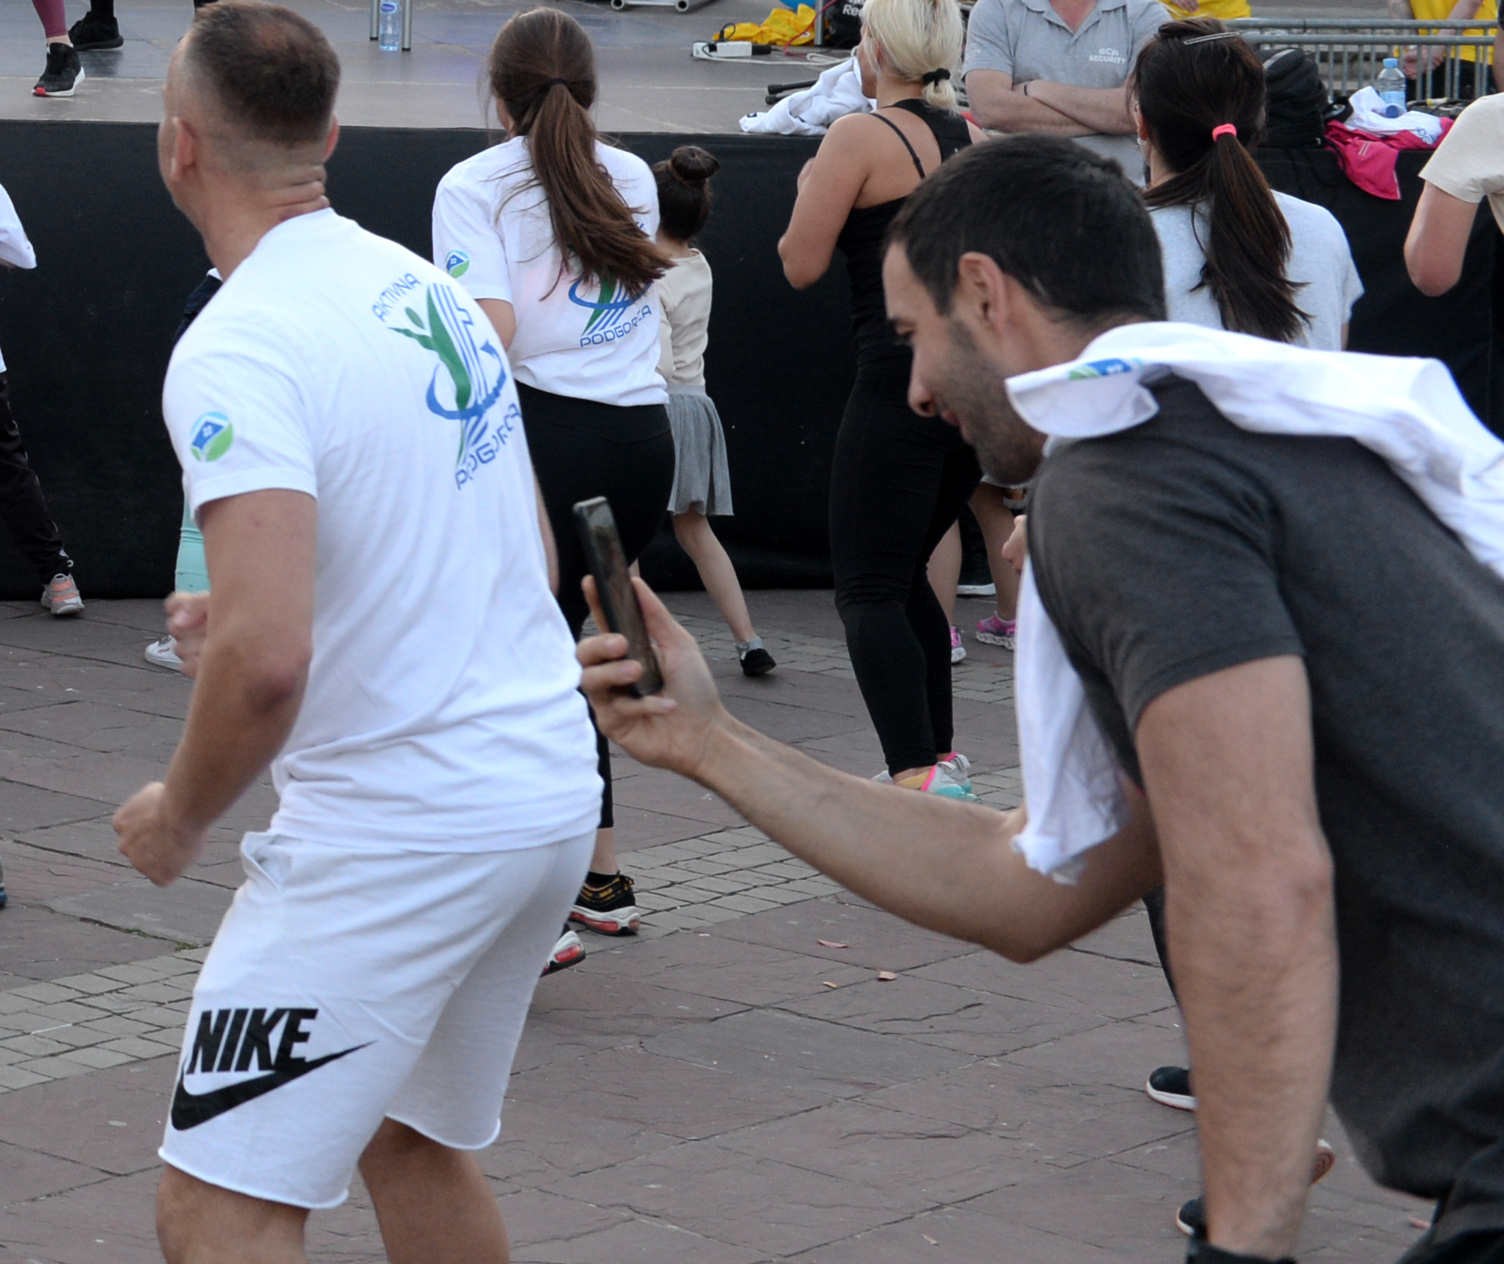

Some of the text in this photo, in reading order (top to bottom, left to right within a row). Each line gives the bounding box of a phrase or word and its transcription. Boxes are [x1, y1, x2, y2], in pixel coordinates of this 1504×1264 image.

[1089, 54, 1127, 65] SECURITY
[371, 272, 422, 322] AKTIVNA
[186, 1007, 318, 1075] NIKE
